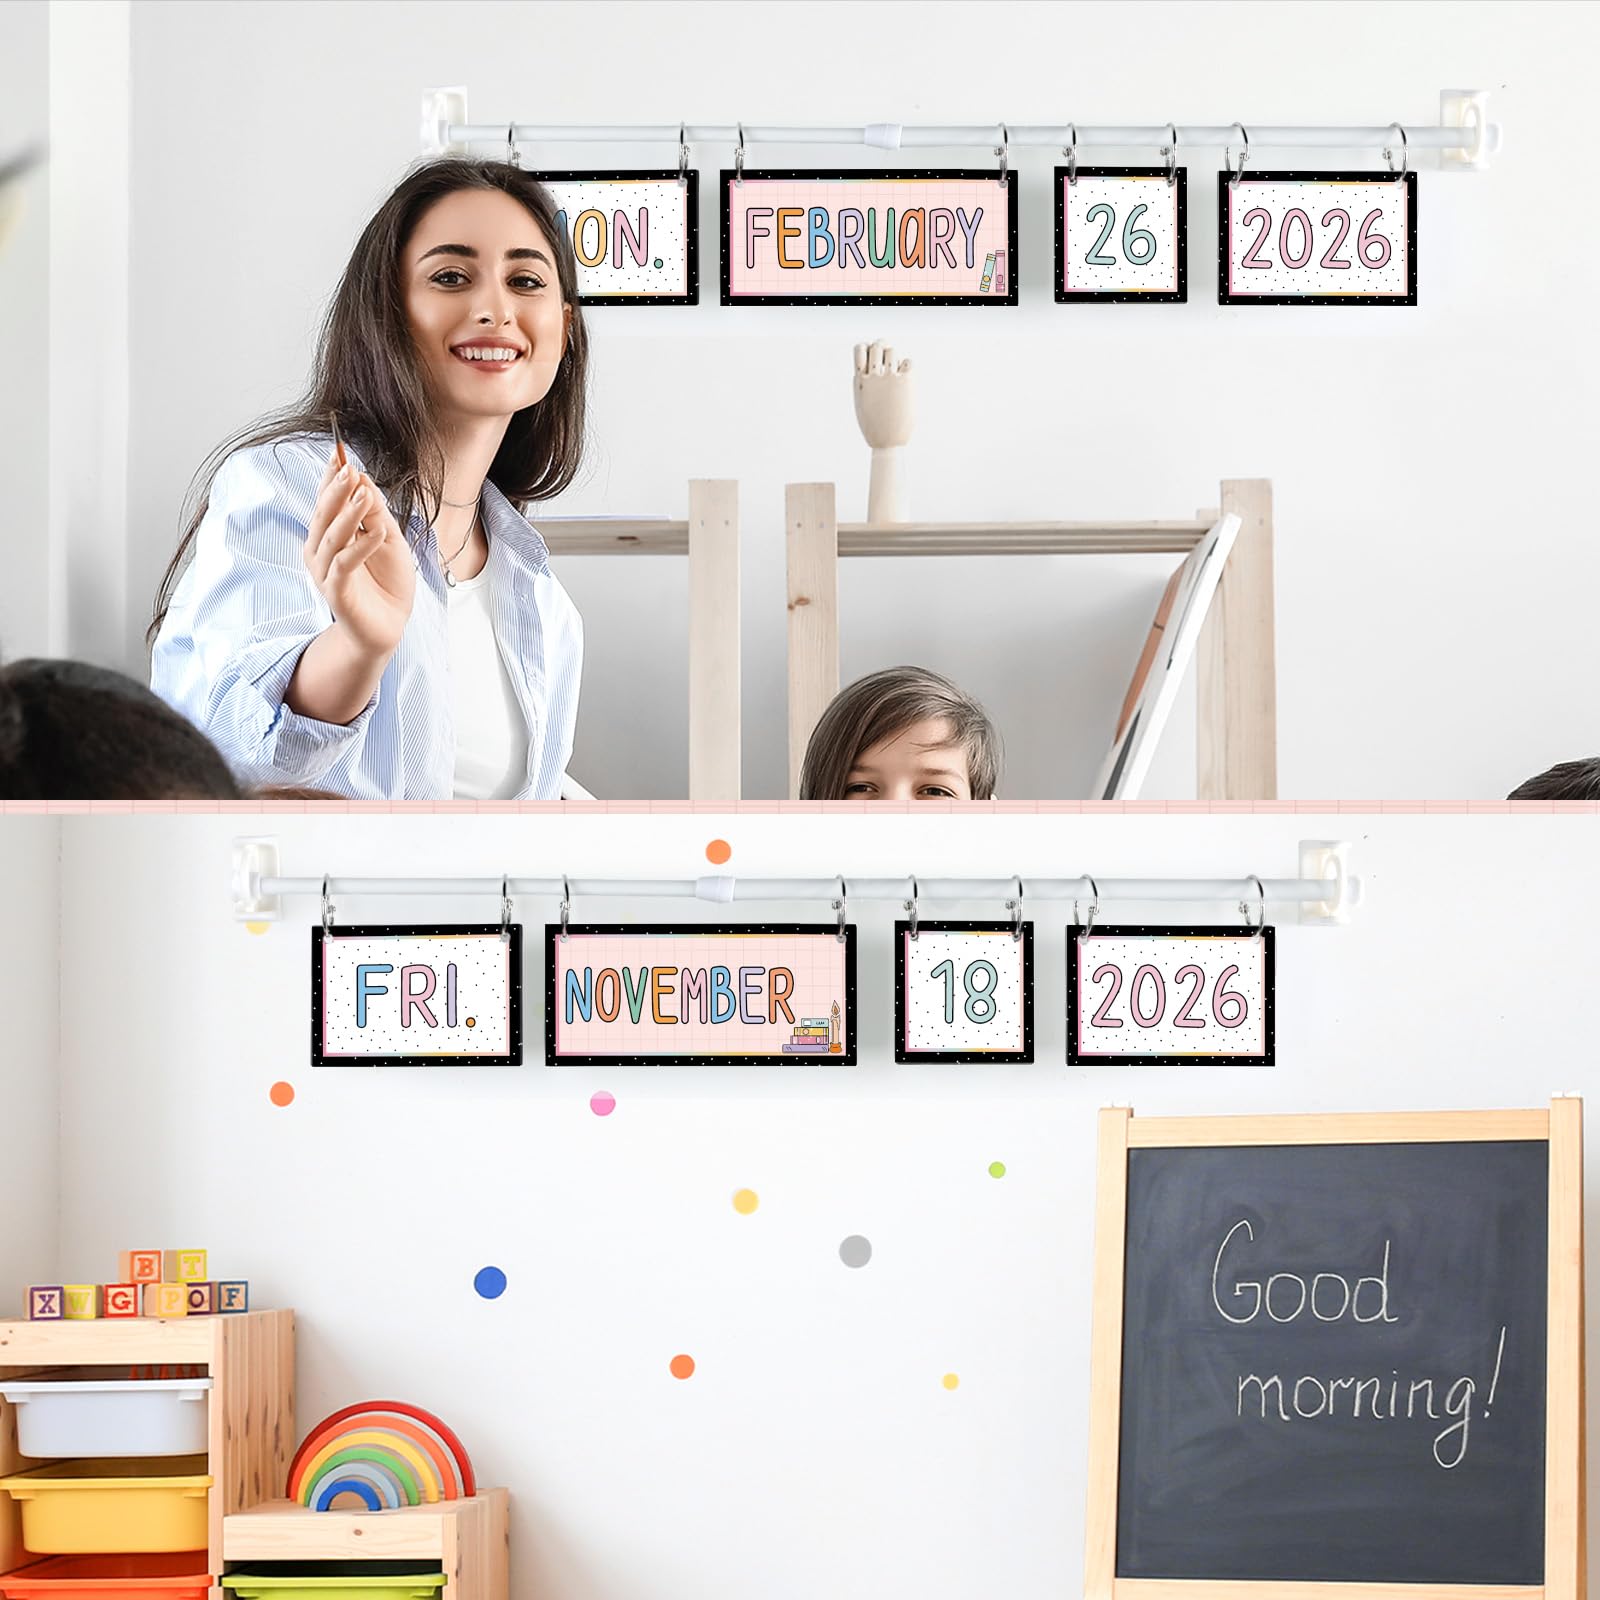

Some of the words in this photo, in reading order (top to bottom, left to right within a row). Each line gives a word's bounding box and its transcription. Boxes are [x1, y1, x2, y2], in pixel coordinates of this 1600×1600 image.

[1085, 203, 1157, 266] 26
[1241, 207, 1392, 270] 2026
[356, 962, 476, 1029] FRI.
[565, 965, 796, 1025] NOVEMBER
[930, 959, 999, 1025] 18
[1090, 963, 1249, 1029] 2026
[137, 1257, 154, 1277] B
[183, 1256, 200, 1276] T
[1212, 1219, 1399, 1324] Good
[38, 1293, 56, 1314] X
[68, 1291, 90, 1313] W
[111, 1291, 131, 1310] G
[165, 1291, 179, 1310] P
[189, 1289, 204, 1308] O
[225, 1288, 240, 1307] F
[1234, 1325, 1507, 1469] morning!
